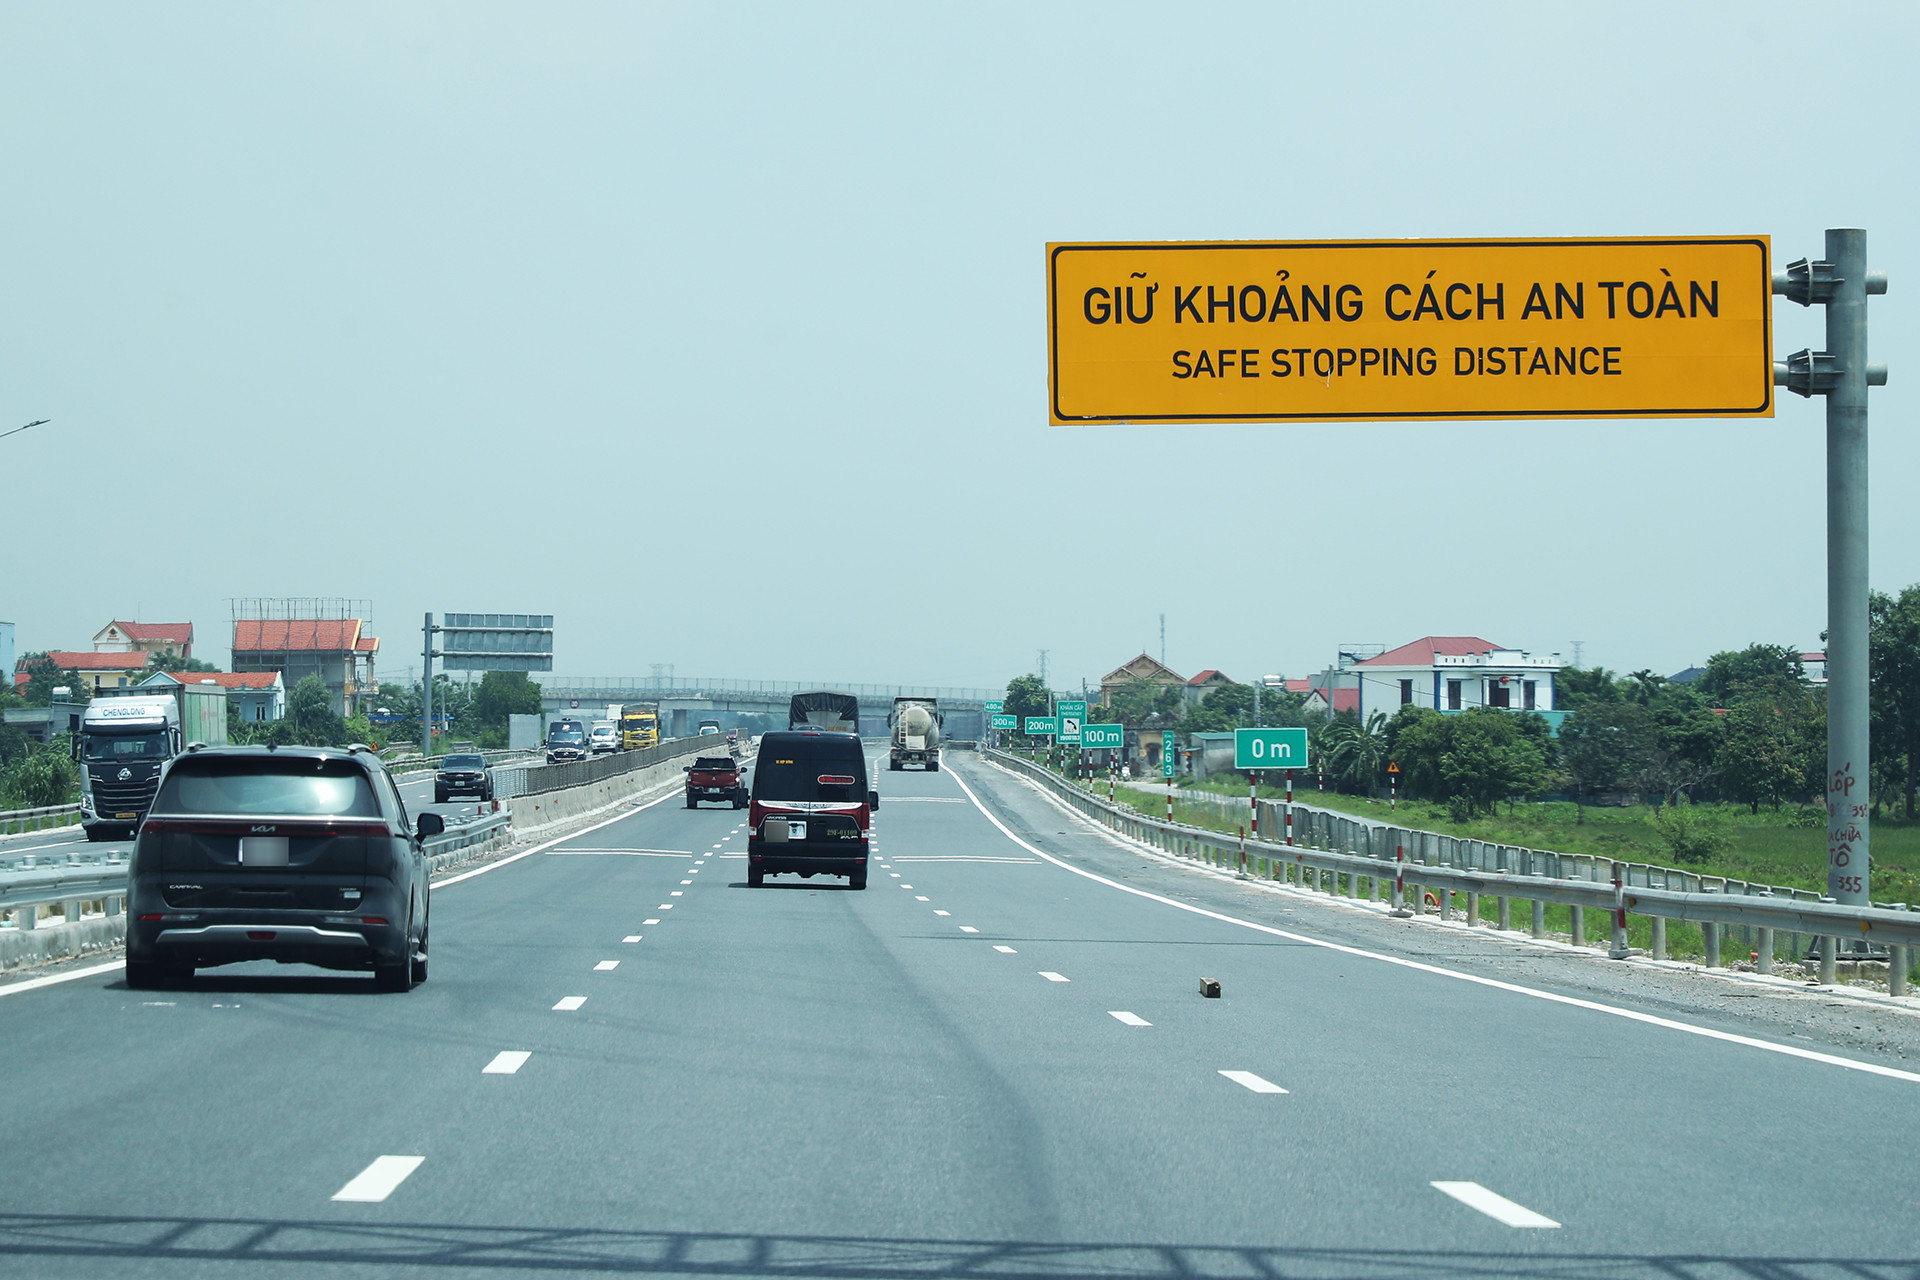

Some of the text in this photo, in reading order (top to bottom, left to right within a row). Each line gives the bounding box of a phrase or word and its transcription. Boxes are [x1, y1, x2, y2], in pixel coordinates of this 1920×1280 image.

[1084, 268, 1719, 325] GIỮ KHOẢNG CÁCH AN TOÀN
[1172, 346, 1622, 379] SAFE STOPPING DISTANCE
[102, 707, 146, 717] CHENGLONG
[993, 718, 1008, 726] 300
[1028, 721, 1044, 730] 200
[1085, 730, 1119, 742] 100 m
[1252, 738, 1291, 758] 0 m
[1829, 762, 1855, 797] LỐP
[1838, 875, 1863, 894] 355
